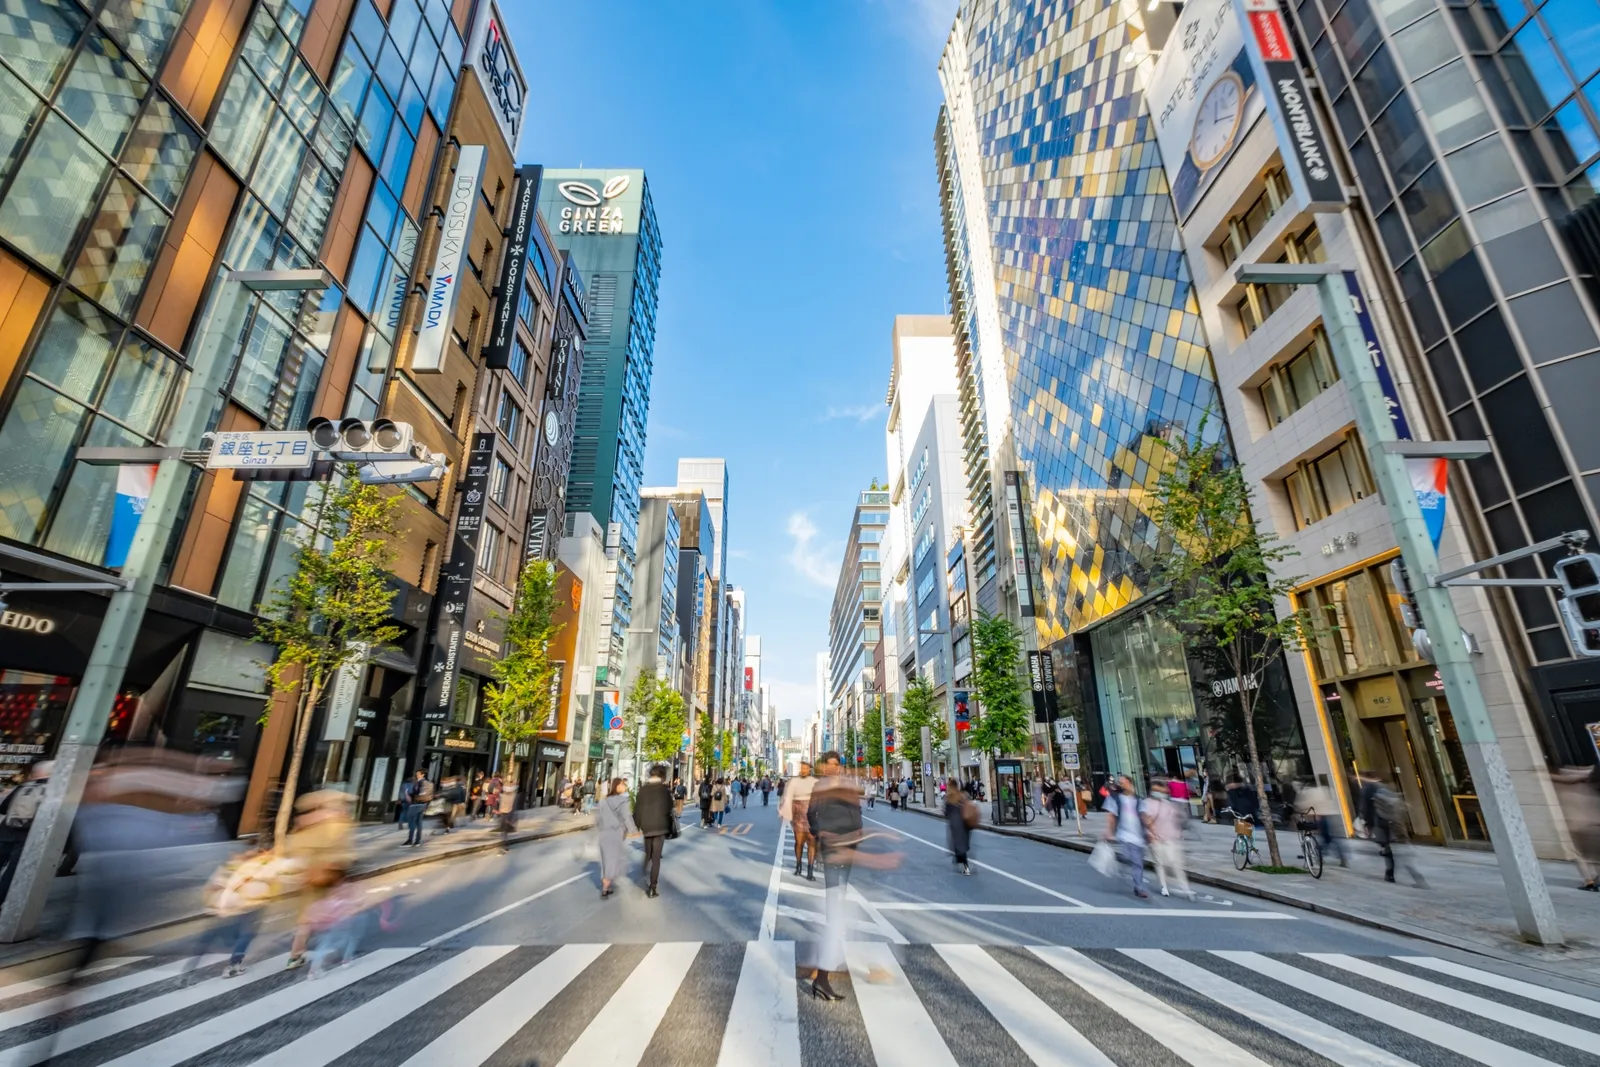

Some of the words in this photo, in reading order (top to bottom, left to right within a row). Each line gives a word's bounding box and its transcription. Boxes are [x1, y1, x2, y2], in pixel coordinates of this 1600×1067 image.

[1160, 74, 1193, 128] PATEK
[1277, 78, 1324, 168] MONTBLANC
[443, 200, 468, 258] OTSUKA
[515, 179, 533, 242] VACHERON
[559, 220, 623, 233] GREEN
[561, 207, 623, 220] GINZA
[426, 274, 453, 329] YAMADA
[497, 259, 519, 346] CONSTANTIN
[554, 339, 568, 397] DAMIANI
[218, 440, 308, 456] 銀座七丁目
[222, 432, 251, 440] 中央区
[242, 456, 268, 465] Ginza
[271, 456, 278, 464] 7
[439, 672, 452, 708] VACHERON
[446, 630, 460, 671] CONSTANTIN
